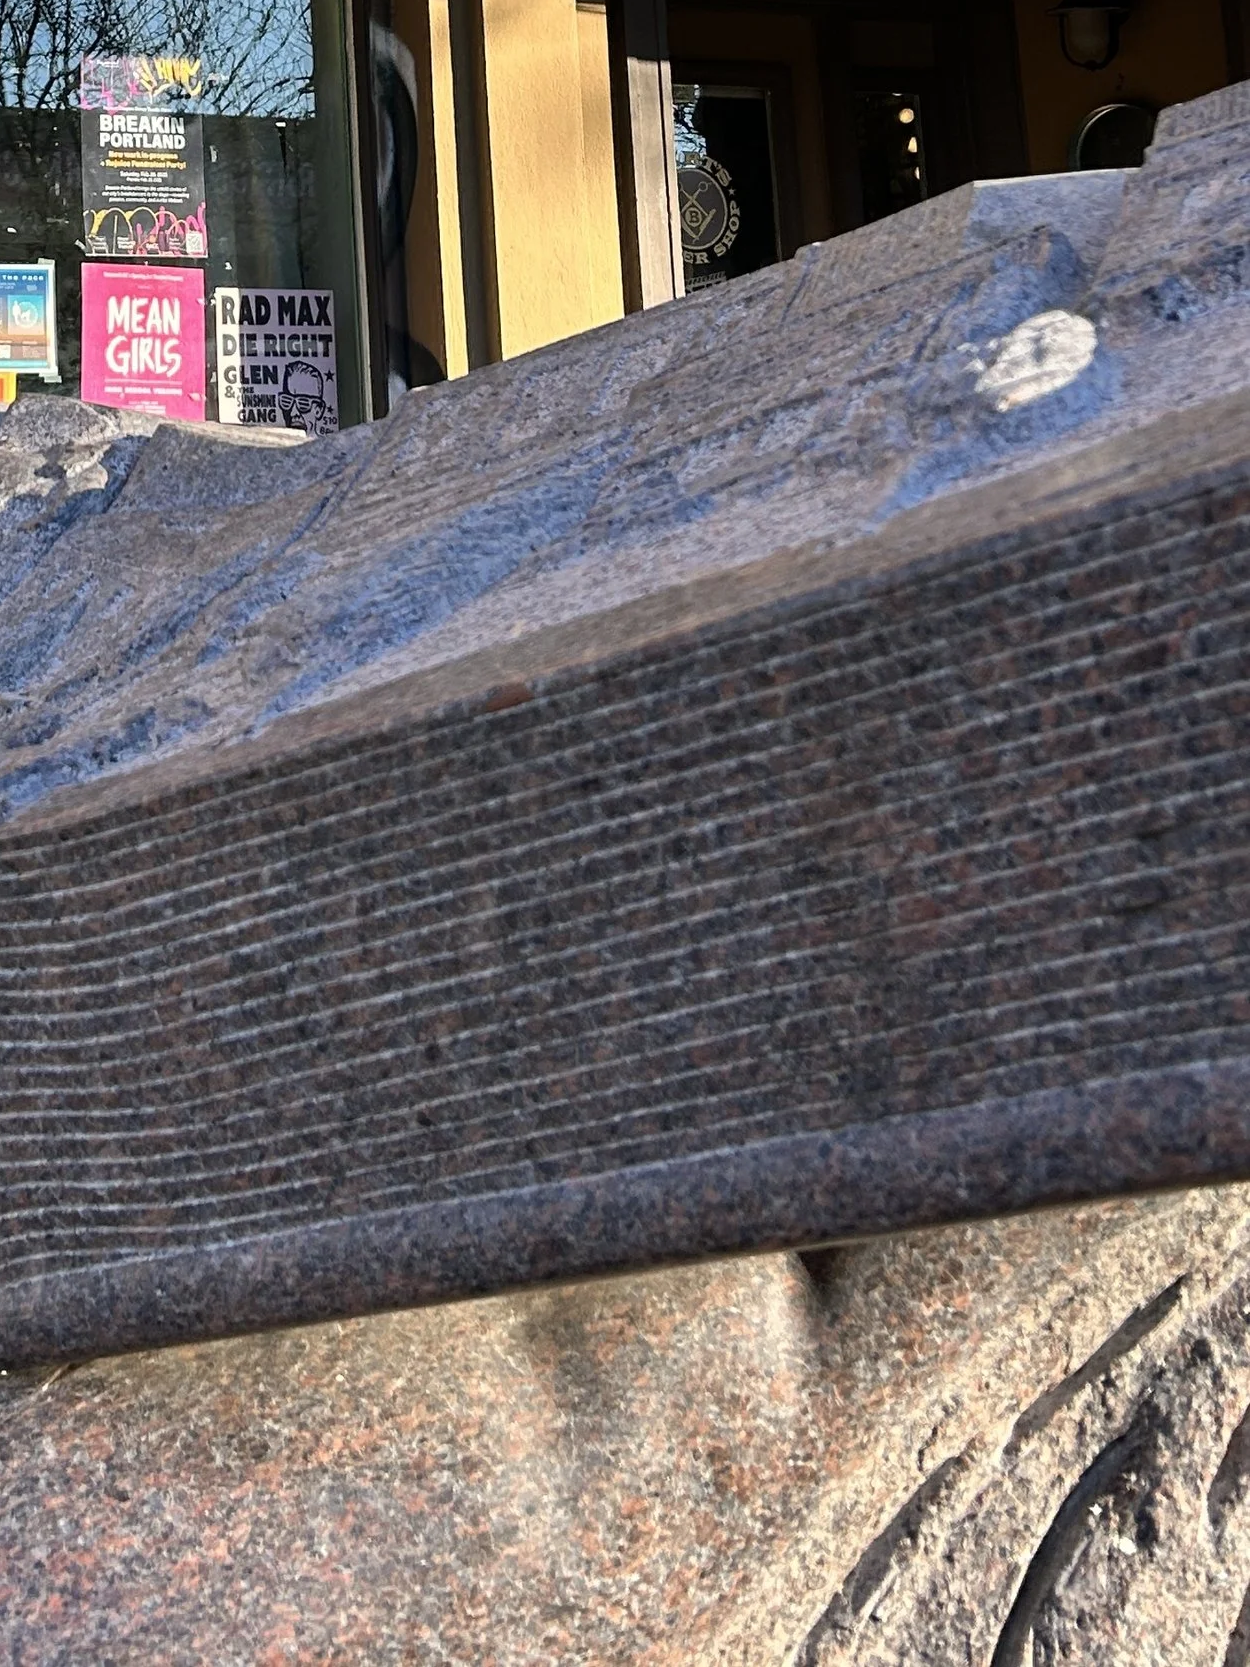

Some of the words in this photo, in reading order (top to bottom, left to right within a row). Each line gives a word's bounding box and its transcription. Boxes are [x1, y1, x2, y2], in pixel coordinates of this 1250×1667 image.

[99, 114, 185, 134] BREAKIN
[99, 132, 186, 149] PORTLAND
[688, 210, 700, 224] B
[713, 200, 741, 258] SHOP
[107, 294, 181, 335] MEAN
[221, 294, 271, 326] RAD
[277, 295, 332, 327] MAX
[222, 333, 258, 357] DIE
[263, 334, 333, 358] RIGHT
[105, 335, 182, 378] GIRLS
[223, 364, 279, 385] GLEN
[224, 385, 236, 399] &
[238, 386, 255, 394] THE
[237, 394, 277, 408] SUNSHINE
[237, 408, 277, 423] GANG
